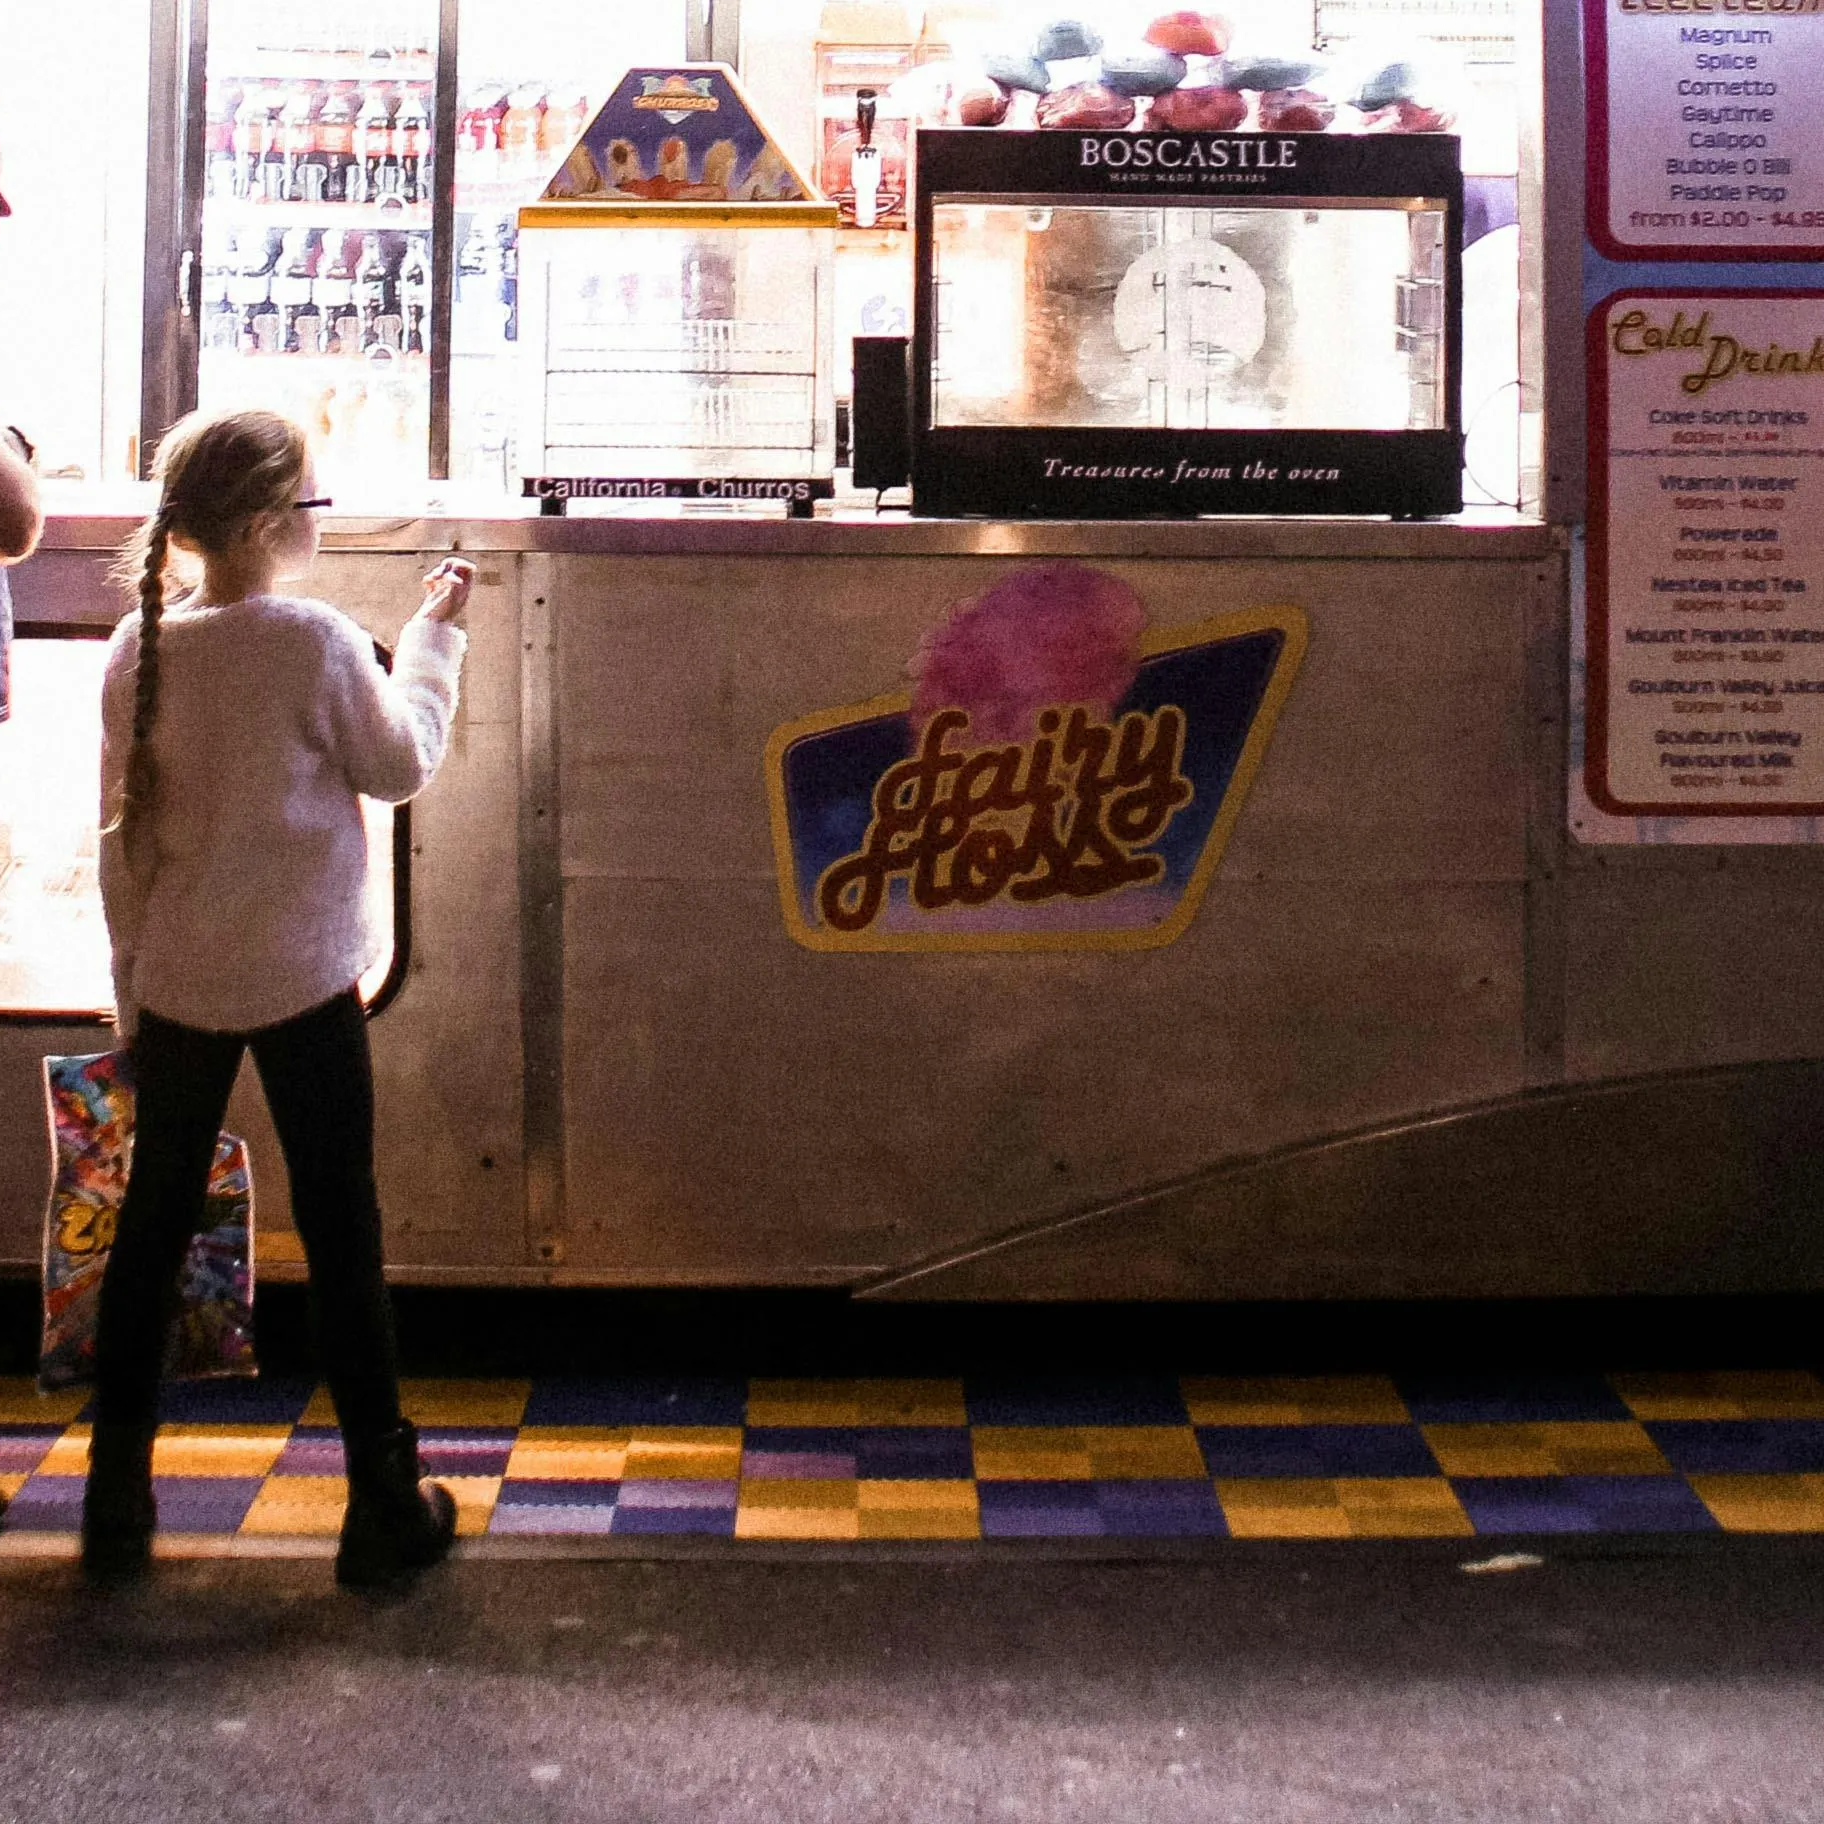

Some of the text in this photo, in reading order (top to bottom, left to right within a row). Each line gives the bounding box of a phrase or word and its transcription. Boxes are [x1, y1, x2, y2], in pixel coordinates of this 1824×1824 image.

[1680, 27, 1772, 45] Magnum
[1696, 54, 1757, 71] Splice
[1677, 79, 1776, 96] Cornetto
[1682, 105, 1774, 123] Gaytime
[1688, 132, 1766, 150] Calippo
[1080, 138, 1298, 168] BOSCASTLE
[1665, 158, 1737, 175] Bubble
[1669, 184, 1787, 202] Paddle Pop
[1629, 211, 1685, 227] from
[1612, 310, 1712, 355] Cold
[1702, 409, 1740, 425] Soft
[1747, 409, 1809, 425] Drinks
[1044, 458, 1339, 484] Treasures from the oven
[533, 477, 810, 500] California Churros
